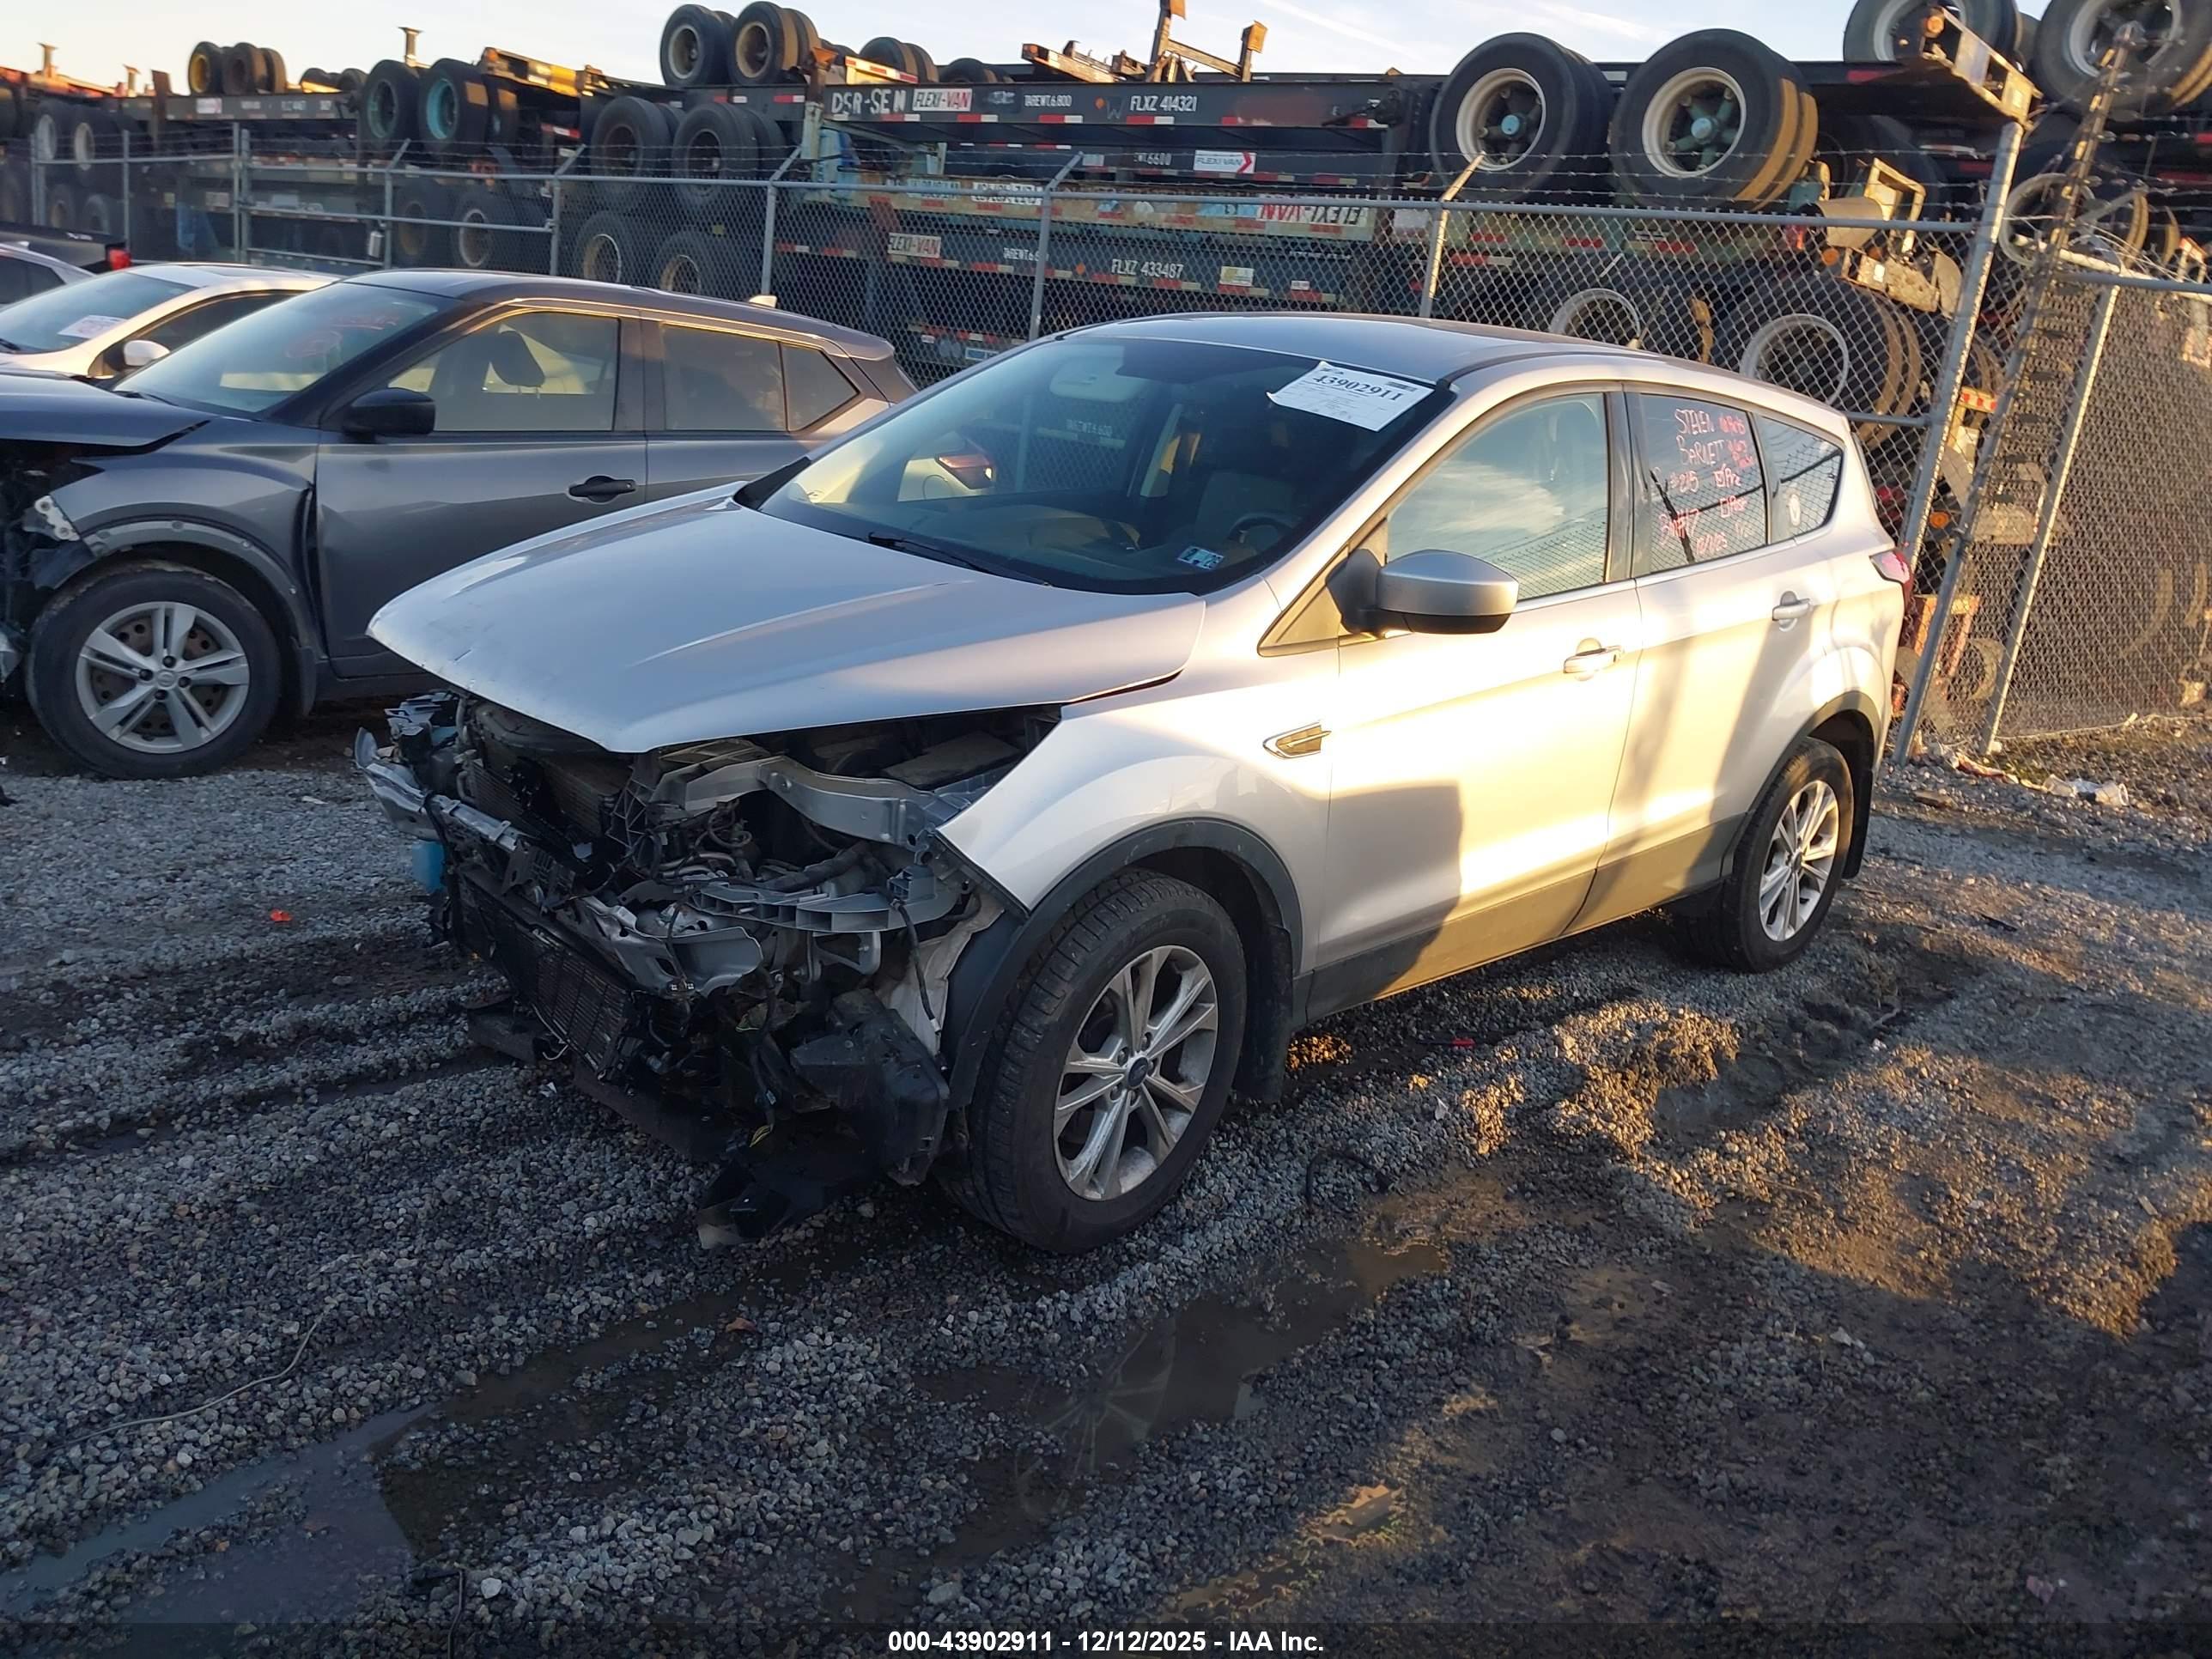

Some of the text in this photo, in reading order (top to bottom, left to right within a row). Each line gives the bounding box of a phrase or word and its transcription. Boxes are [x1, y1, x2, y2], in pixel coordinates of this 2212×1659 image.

[914, 90, 969, 109] FLEXI-VAN
[1129, 94, 1198, 112] FLXZ 414321
[1111, 258, 1138, 276] FLXZ
[1312, 374, 1404, 401] 43902911
